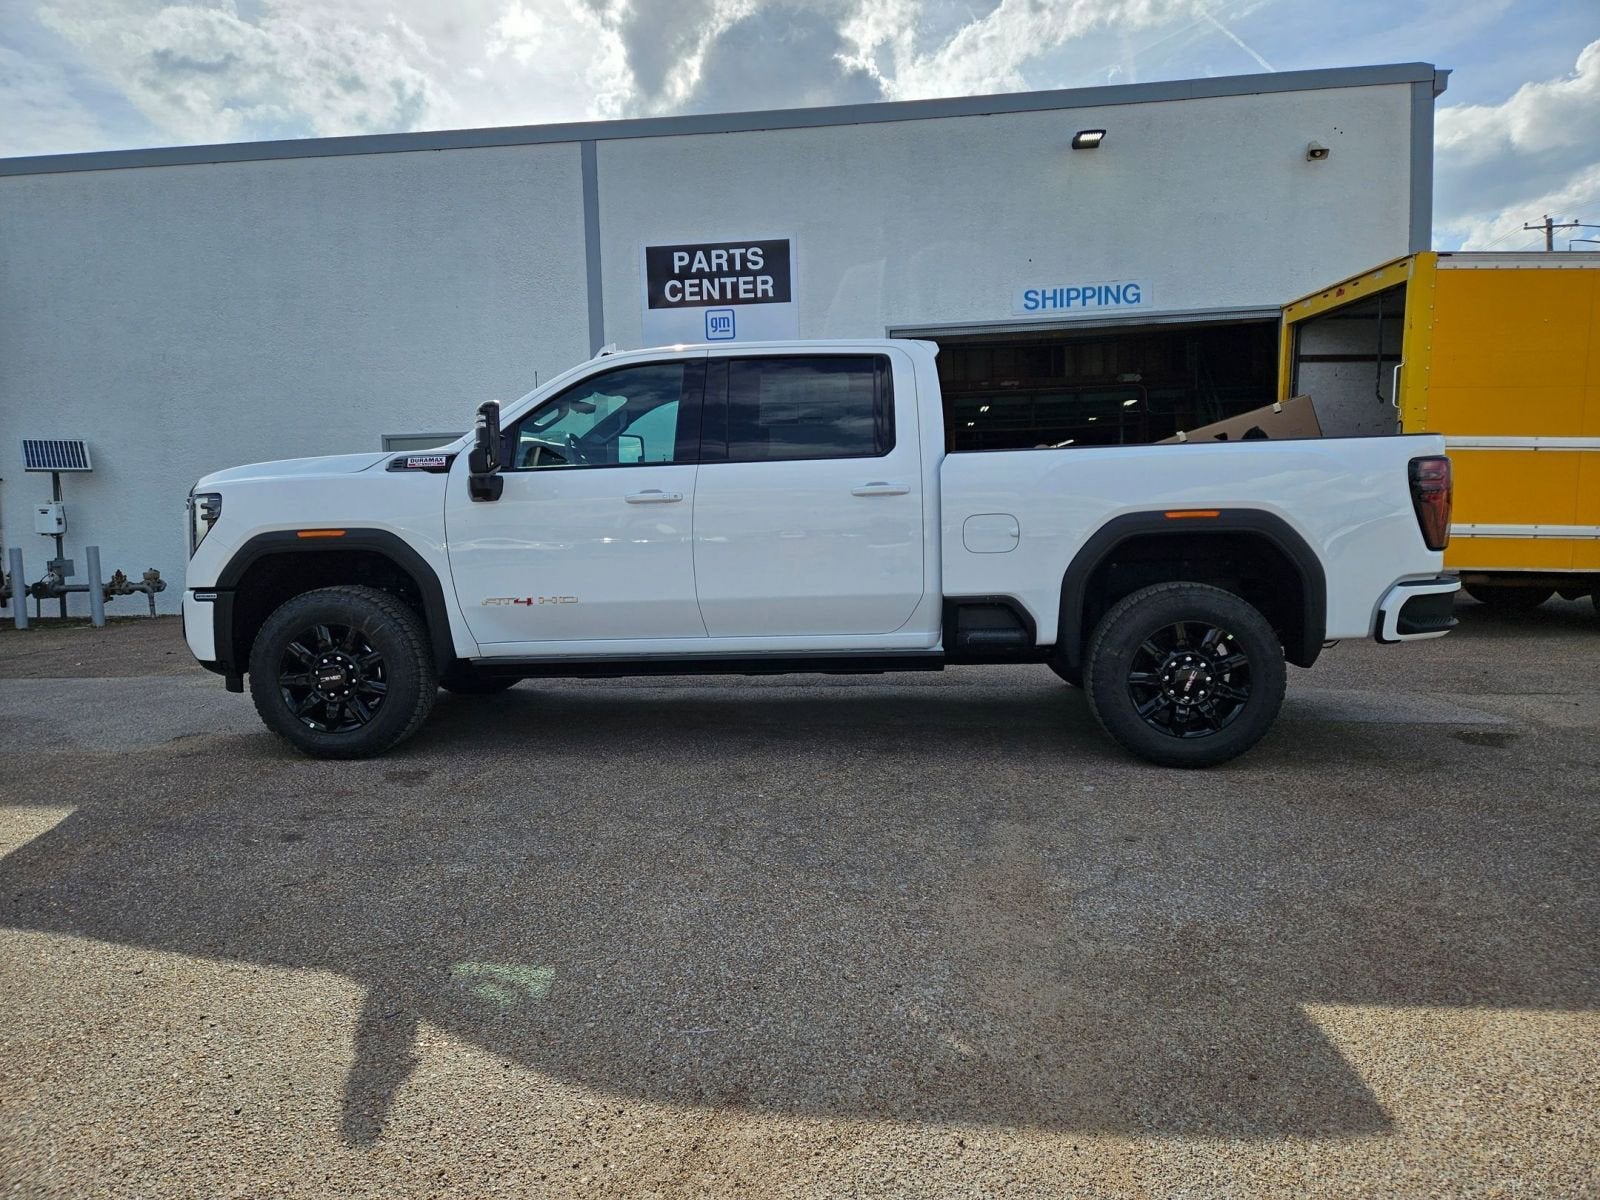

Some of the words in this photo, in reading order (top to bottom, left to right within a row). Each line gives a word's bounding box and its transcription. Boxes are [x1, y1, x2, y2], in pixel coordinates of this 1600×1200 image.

[673, 247, 764, 274] PARTS
[664, 275, 774, 302] CENTER
[1023, 283, 1141, 310] SHIPPING
[711, 316, 730, 333] gm
